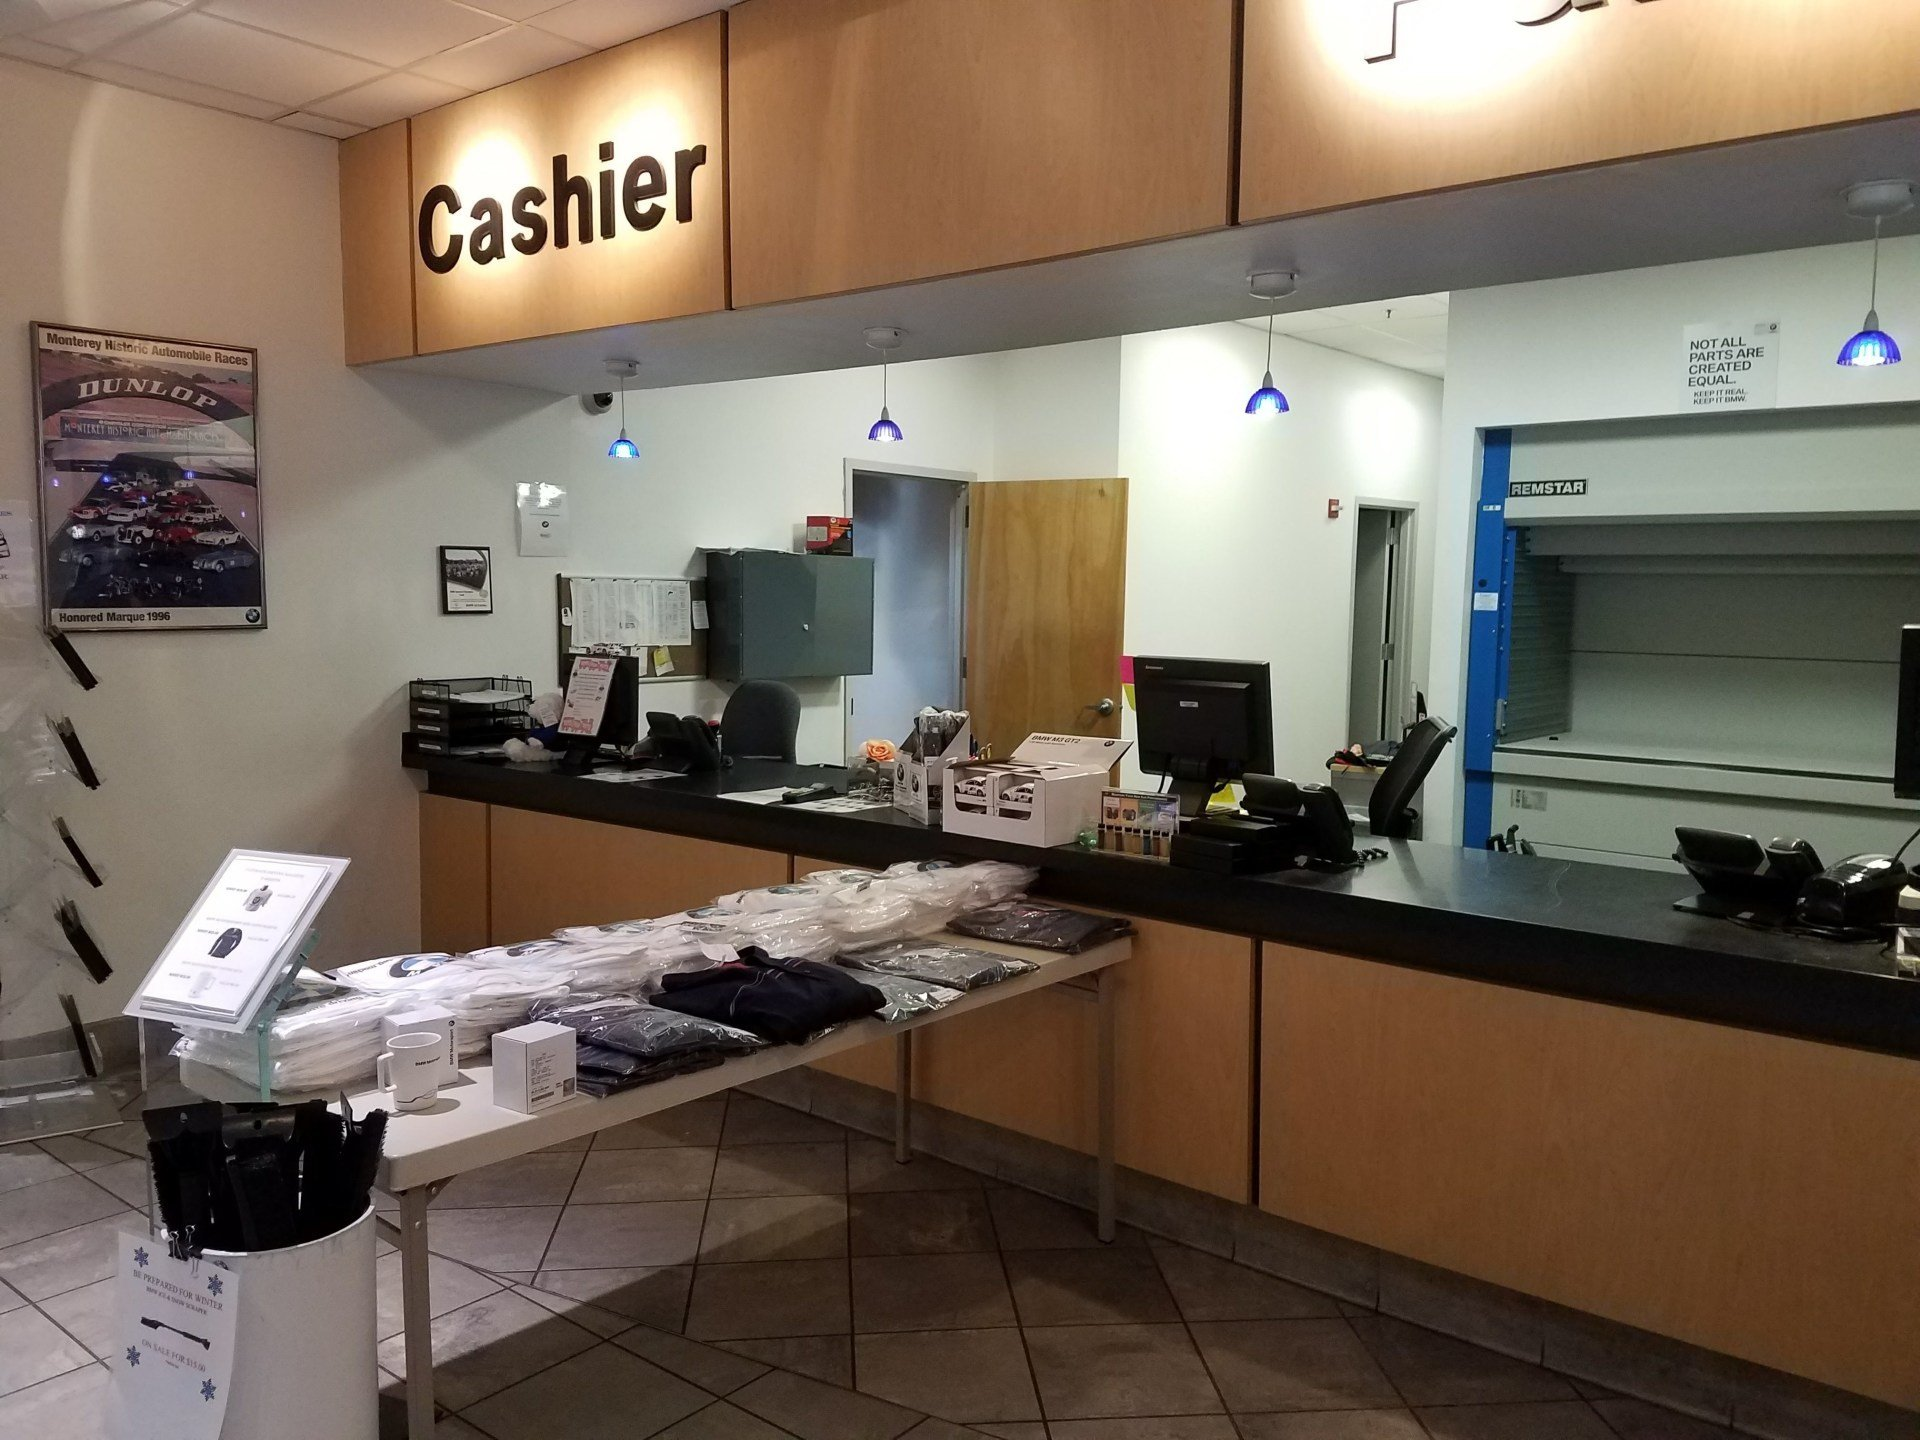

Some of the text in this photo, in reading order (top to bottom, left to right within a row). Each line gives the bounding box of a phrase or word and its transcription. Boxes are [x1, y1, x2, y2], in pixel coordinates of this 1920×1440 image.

[417, 141, 707, 275] Cashier
[46, 332, 249, 366] Monterey Historic Automobile Races
[1690, 336, 1747, 351] NOT ALL
[1689, 346, 1765, 363] PARTS ARE
[1688, 360, 1752, 375] CREATED
[1688, 374, 1737, 388] EQUAL.
[77, 377, 218, 409] DUNLOP
[1693, 389, 1715, 398] KEEP
[1715, 388, 1725, 396] IT
[1693, 397, 1715, 405] KEEP
[1715, 396, 1724, 404] IT
[1511, 481, 1584, 496] REMSTAR
[58, 611, 171, 624] Honored Marque 1996
[133, 1269, 224, 1311] BE PREPARED FOR WINTER
[141, 1338, 153, 1349] ON
[153, 1343, 172, 1356] SALE
[171, 1351, 186, 1364] FOR
